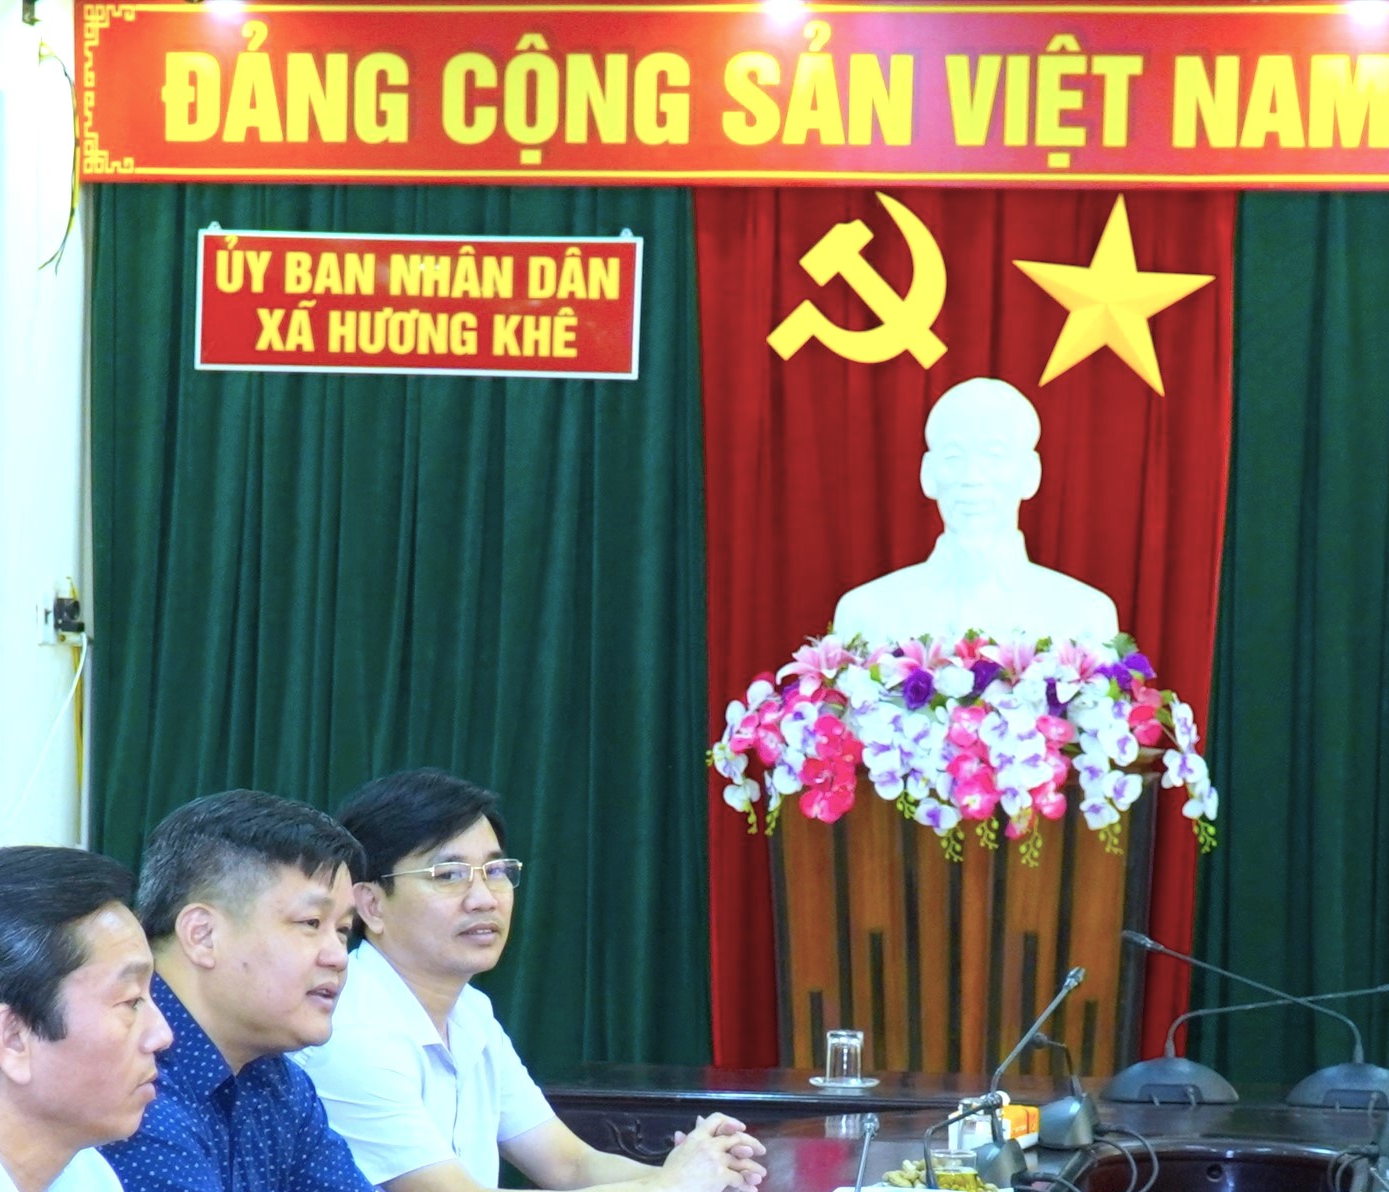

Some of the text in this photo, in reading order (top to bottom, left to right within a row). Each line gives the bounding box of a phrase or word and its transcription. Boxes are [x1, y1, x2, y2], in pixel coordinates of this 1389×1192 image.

[162, 20, 409, 144] ĐẢNG
[441, 33, 691, 165] CỘNG
[721, 20, 915, 147] SẢN
[944, 33, 1144, 168] VIỆT
[215, 235, 620, 300] ỦY BAN NHÂN DÂN
[255, 299, 579, 358] XÃ HƯƠNG KHÊ
